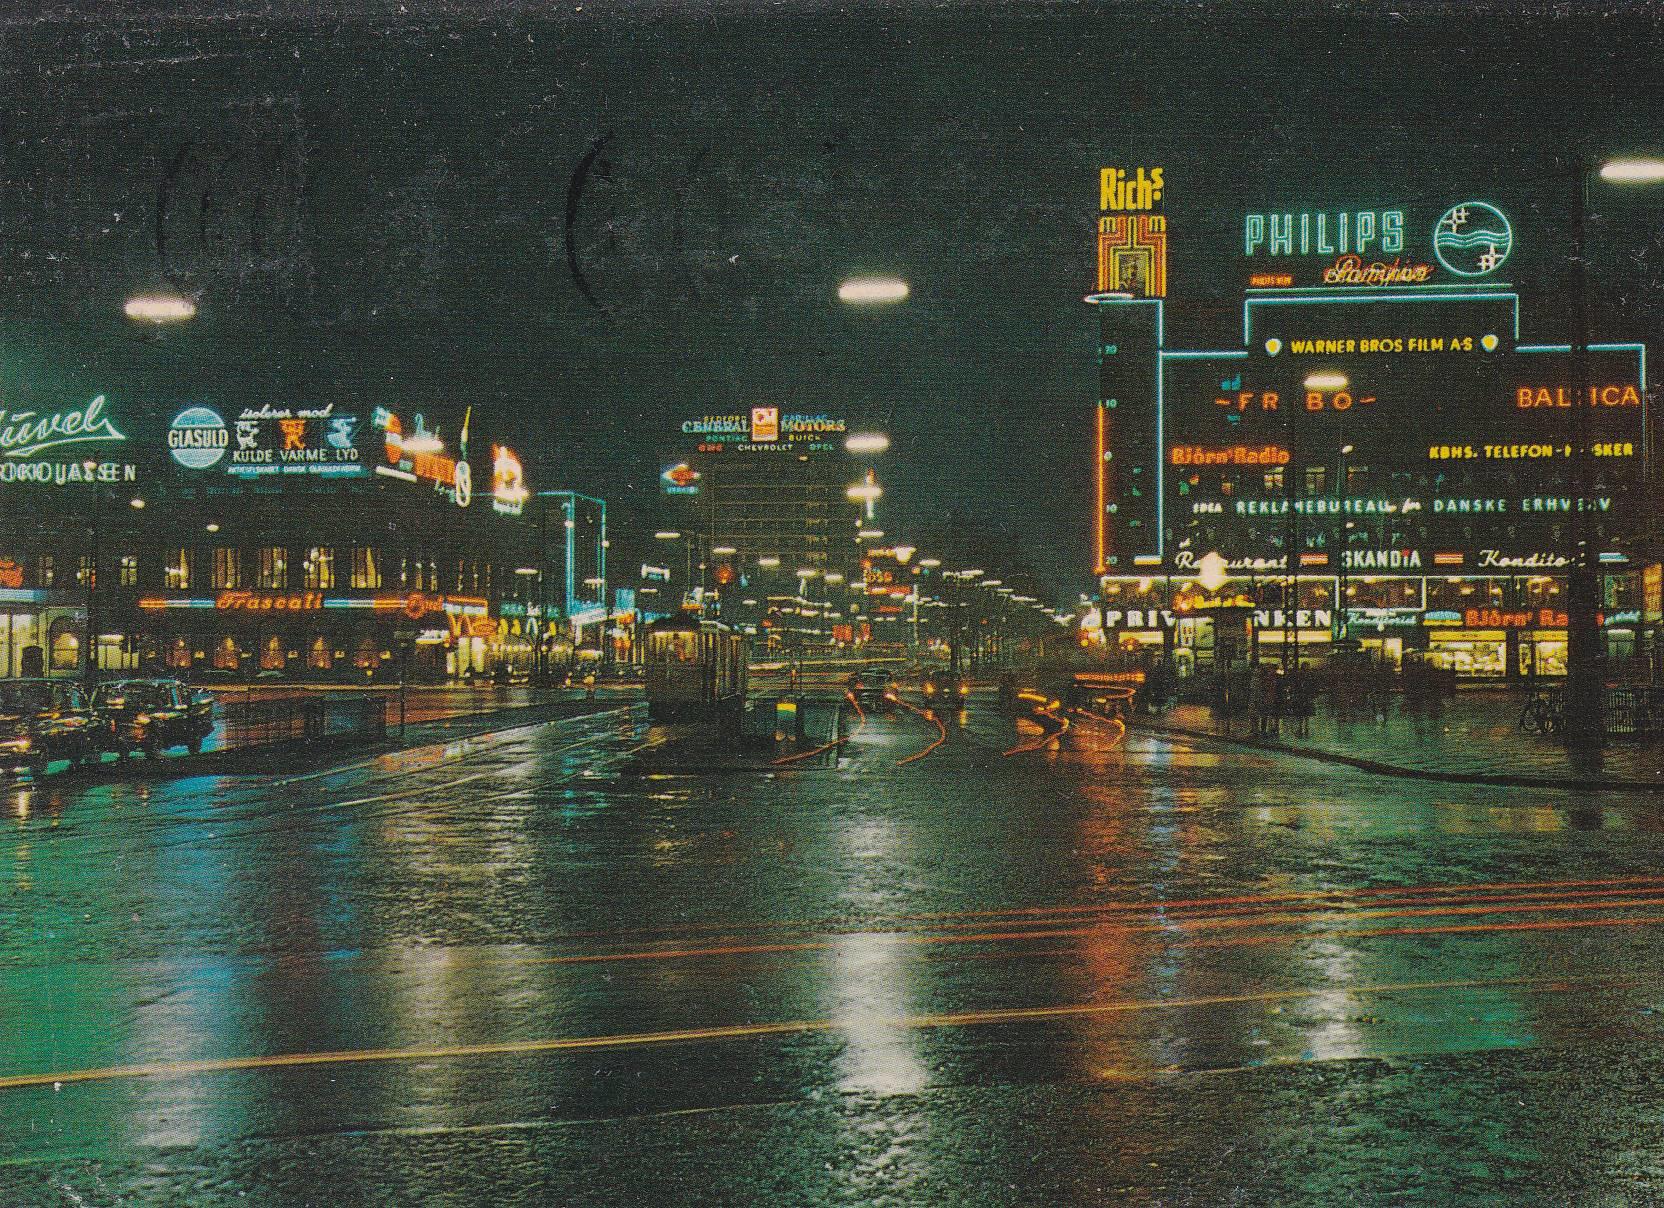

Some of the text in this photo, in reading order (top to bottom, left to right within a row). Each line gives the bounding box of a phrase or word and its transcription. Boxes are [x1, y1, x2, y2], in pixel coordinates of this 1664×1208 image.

[1245, 210, 1404, 257] PHILIPS
[1290, 339, 1356, 354] WARNER
[1359, 338, 1402, 353] BROS
[1407, 338, 1444, 352] FILM
[1516, 385, 1641, 409] BALICA
[681, 420, 847, 433] GENERAL MOTORS
[167, 428, 229, 449] GLASULD
[788, 433, 822, 442] BUICK
[232, 447, 359, 463] KULDE VARME LYD
[736, 443, 793, 452] CHEVROLET
[1233, 444, 1291, 465] Radio
[1433, 498, 1507, 513] DANSKE
[215, 591, 325, 610] Frascati
